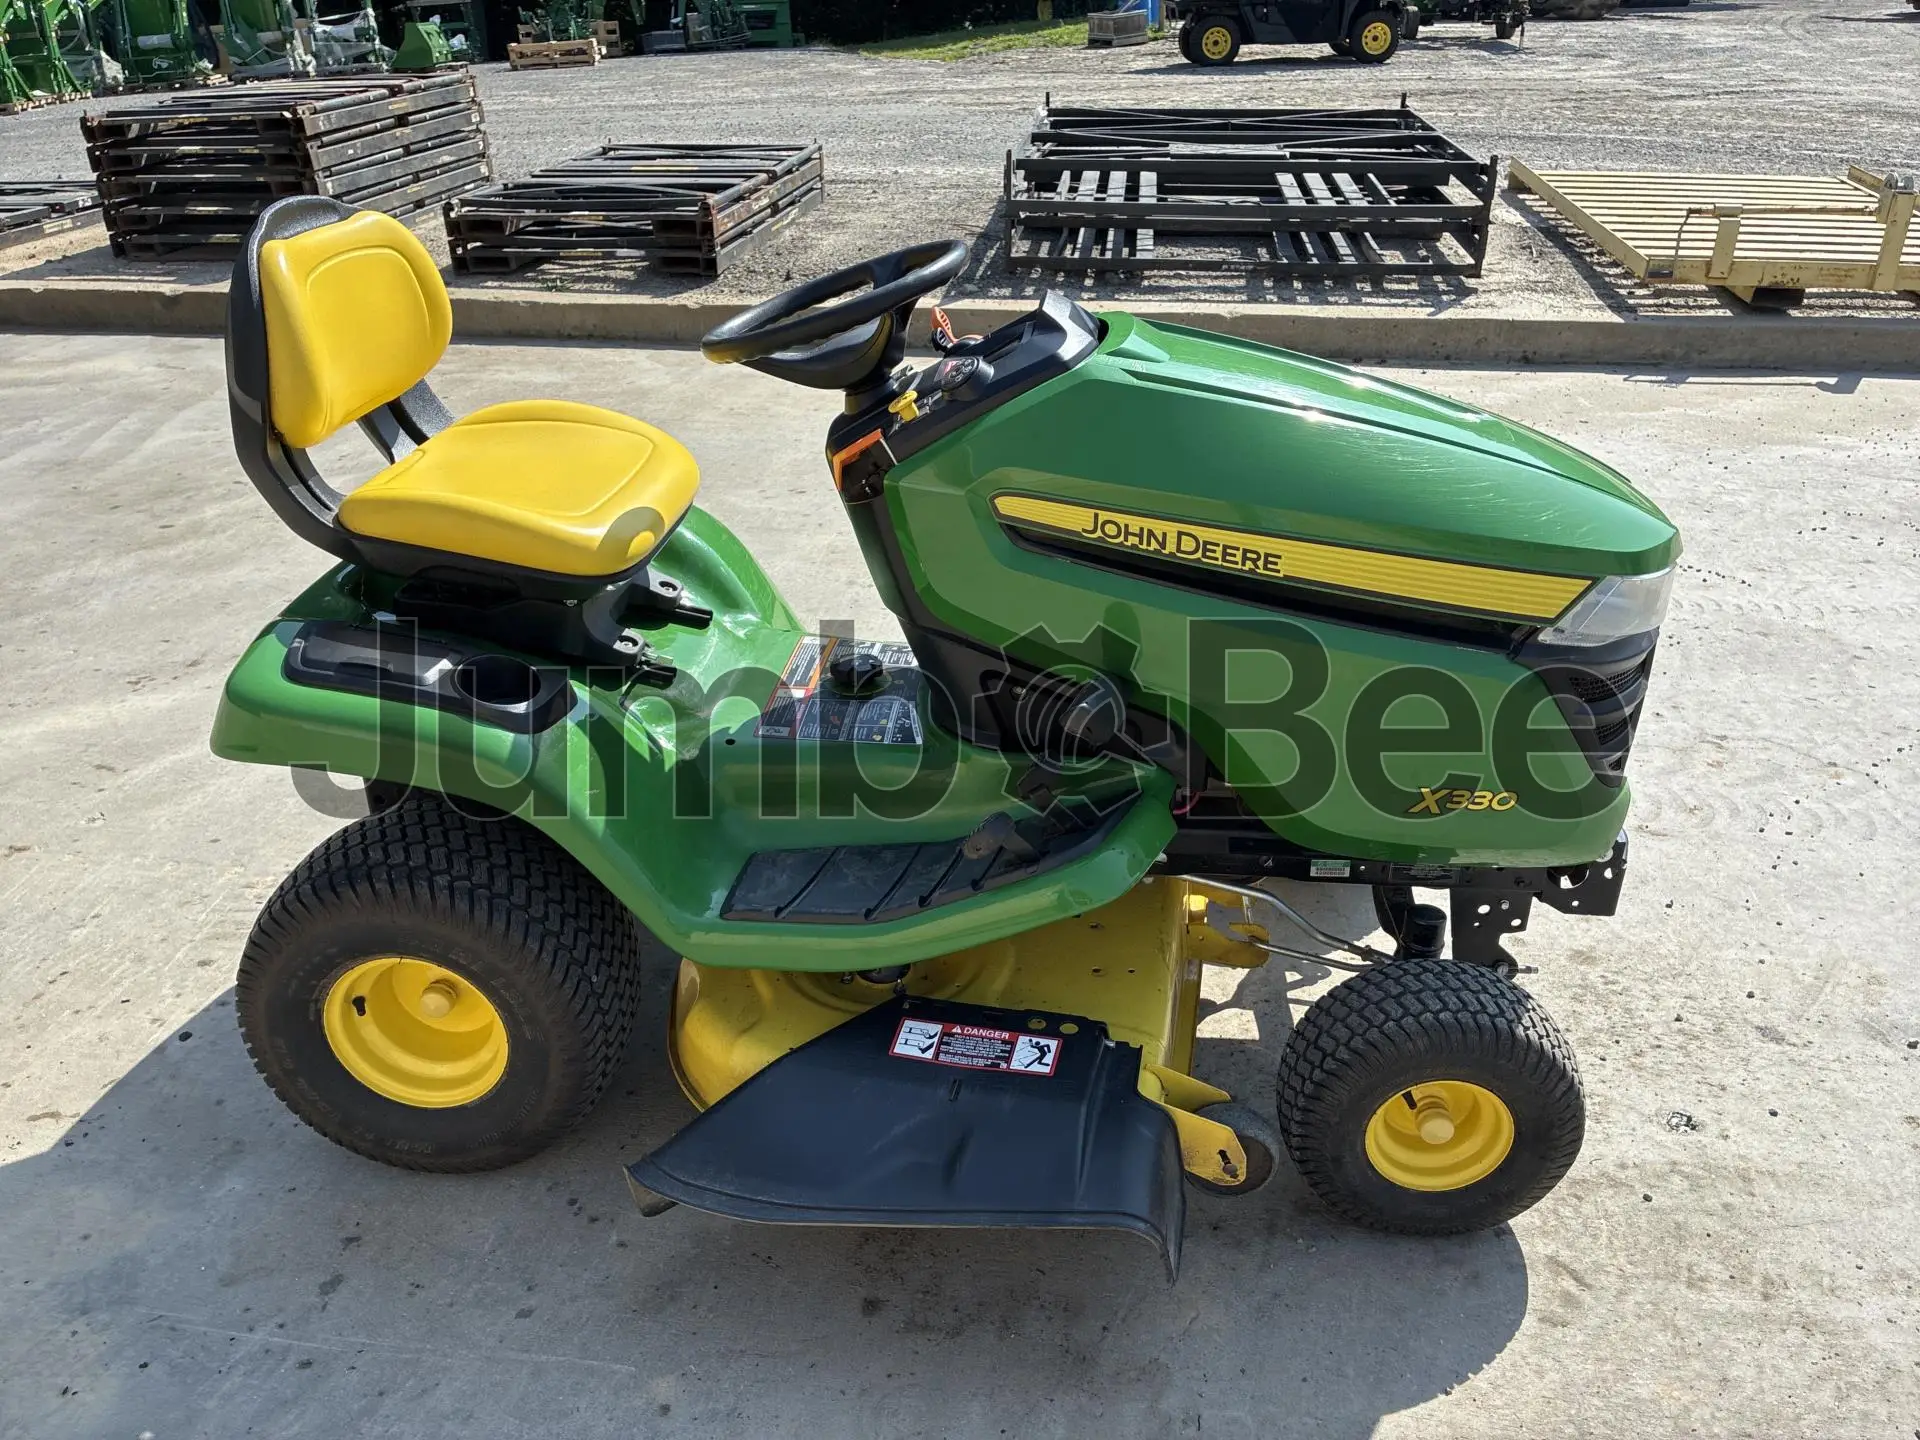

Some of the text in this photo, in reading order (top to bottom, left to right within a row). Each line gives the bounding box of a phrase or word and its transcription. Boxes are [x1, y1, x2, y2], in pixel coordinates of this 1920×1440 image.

[1081, 512, 1282, 574] JOHN DEERE
[1407, 787, 1518, 814] X330
[963, 1027, 1009, 1039] DANGER
